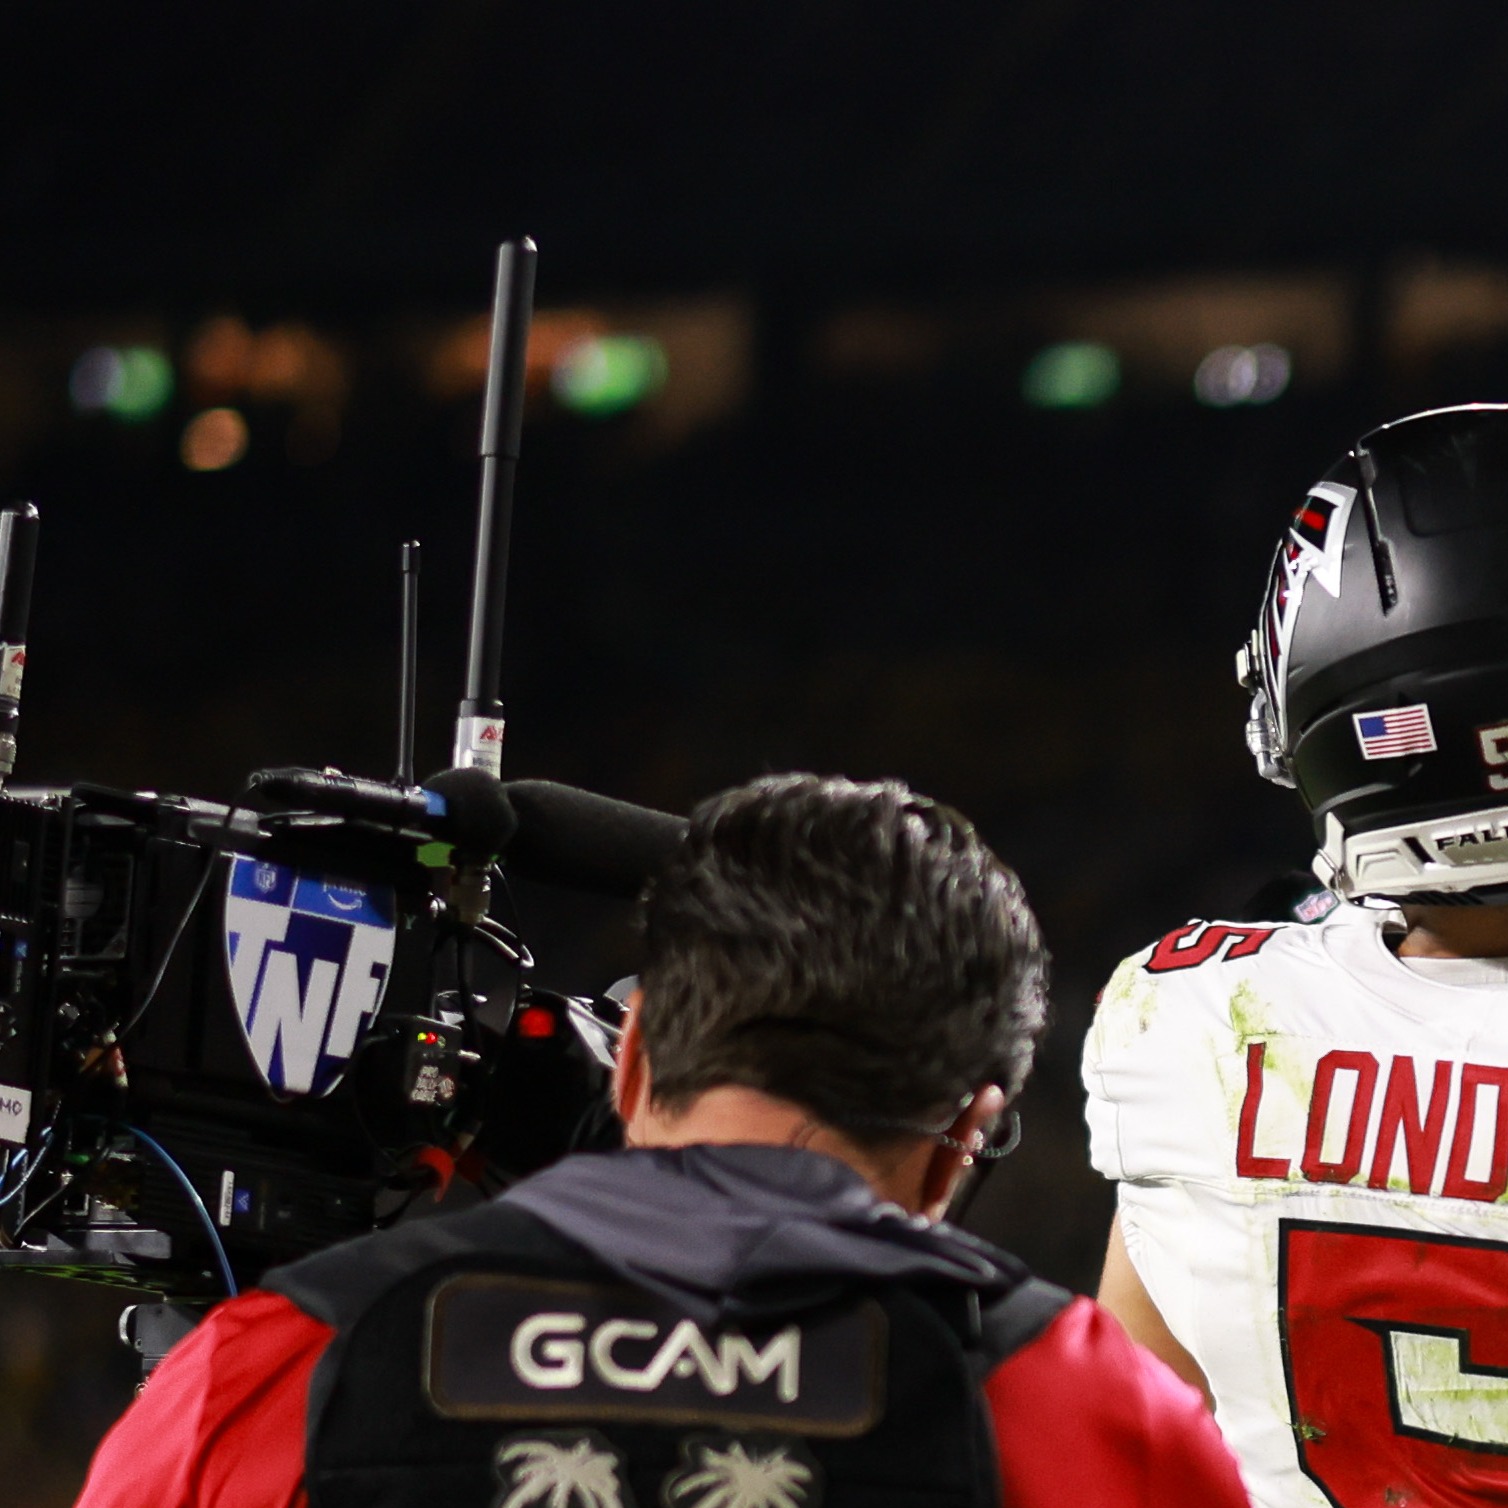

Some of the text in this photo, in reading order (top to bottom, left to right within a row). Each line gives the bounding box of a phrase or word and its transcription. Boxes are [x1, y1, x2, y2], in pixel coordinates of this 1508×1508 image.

[1142, 920, 1288, 975] 5
[226, 899, 396, 1094] TNF
[509, 1312, 801, 1404] GCAM
